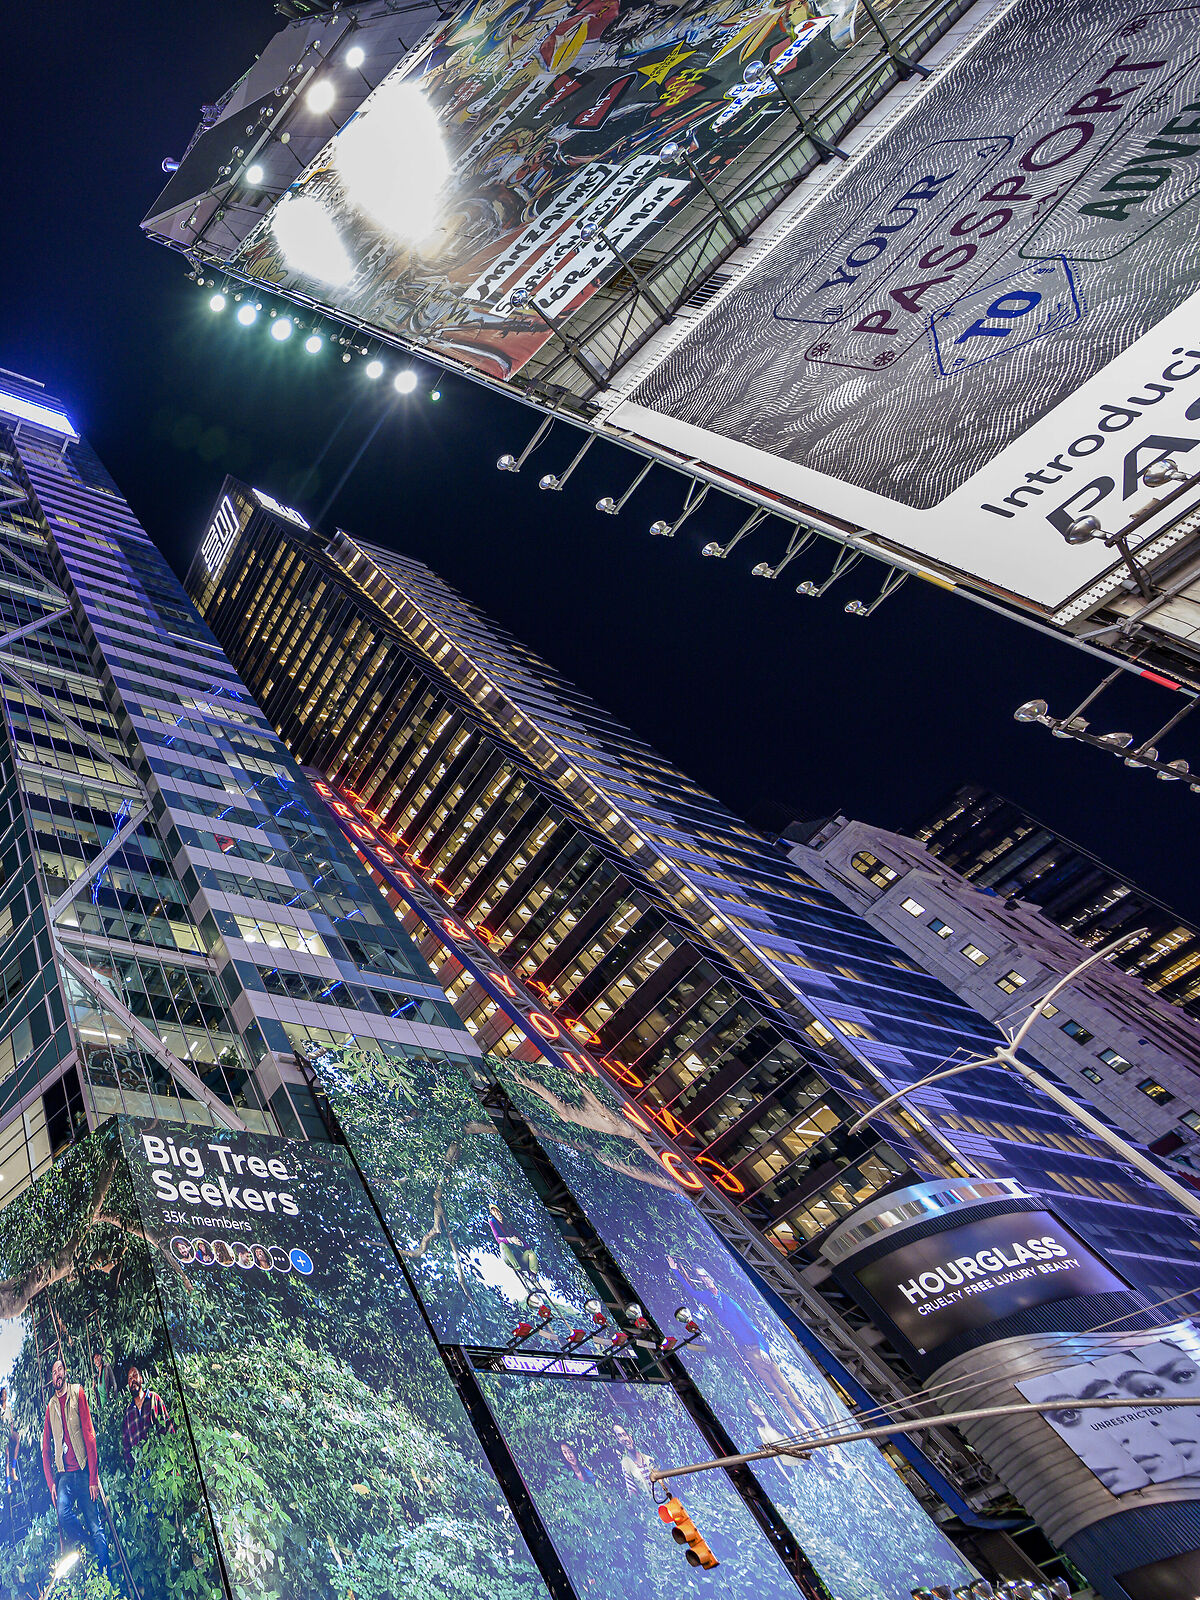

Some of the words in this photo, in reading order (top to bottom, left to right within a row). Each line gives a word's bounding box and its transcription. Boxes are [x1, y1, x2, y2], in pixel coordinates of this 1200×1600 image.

[1078, 90, 1200, 222] ADVE
[851, 54, 1168, 336] PASSPORT
[815, 170, 959, 293] YOUR
[954, 290, 1042, 345] TO
[980, 342, 1200, 519] Introduci
[315, 782, 417, 890] ERNST
[441, 918, 471, 942] &
[141, 1133, 205, 1178] Big
[207, 1143, 291, 1182] Tree
[151, 1169, 300, 1216] Seekers
[163, 1210, 190, 1225] 35K
[191, 1215, 253, 1231] members
[897, 1236, 1069, 1305] HOURGLASS
[917, 1289, 964, 1316] CRUELTY
[963, 1279, 995, 1297] FREE
[993, 1266, 1039, 1287] LUXURY
[1036, 1258, 1082, 1275] BEAUTY
[1090, 1406, 1163, 1431] UNRESTRICTED
